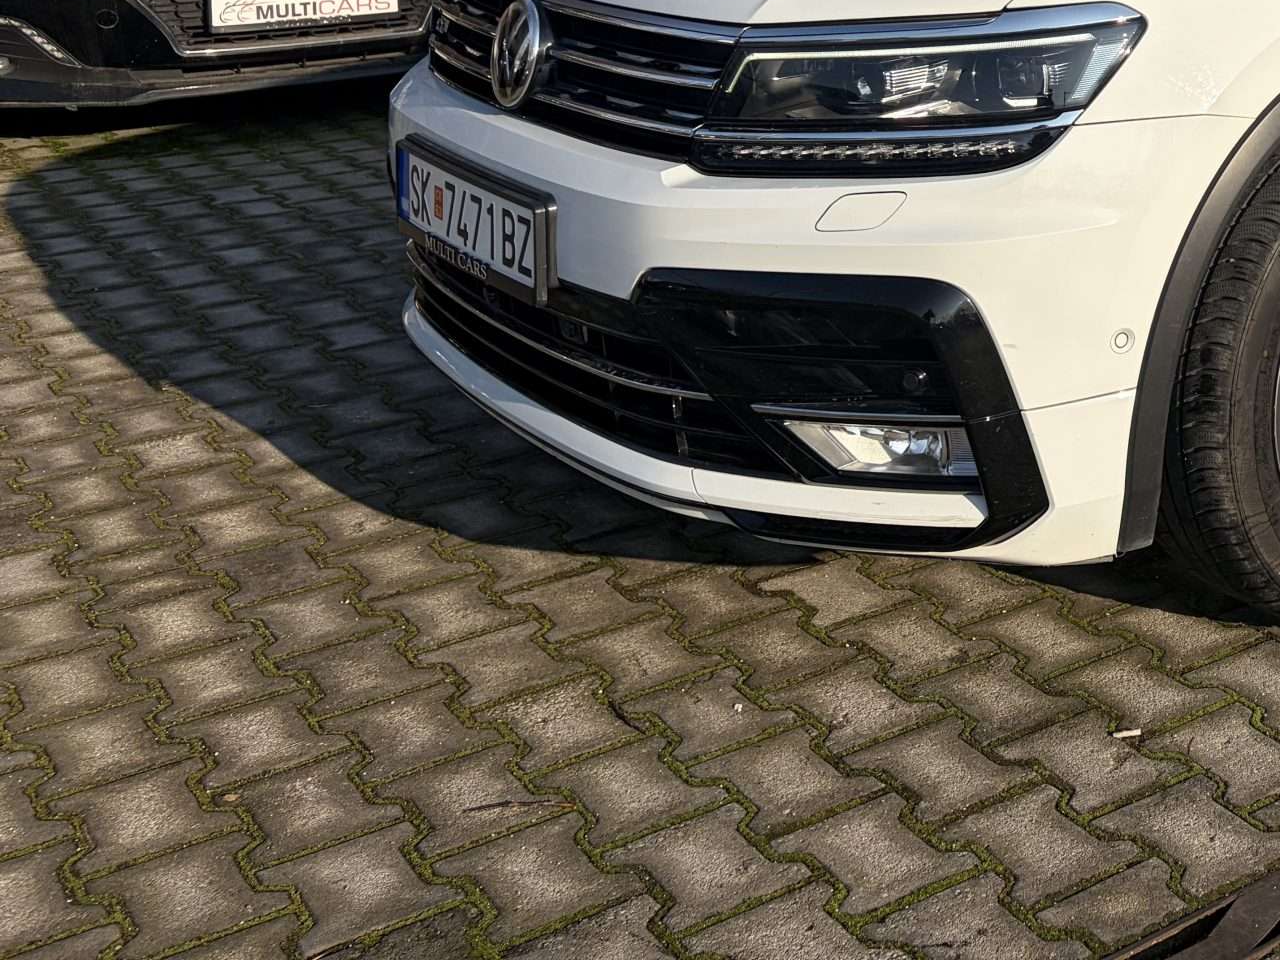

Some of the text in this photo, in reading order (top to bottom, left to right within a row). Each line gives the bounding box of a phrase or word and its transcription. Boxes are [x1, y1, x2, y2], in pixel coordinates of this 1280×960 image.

[411, 164, 431, 226] SK
[425, 236, 488, 280] MULTI CARS
